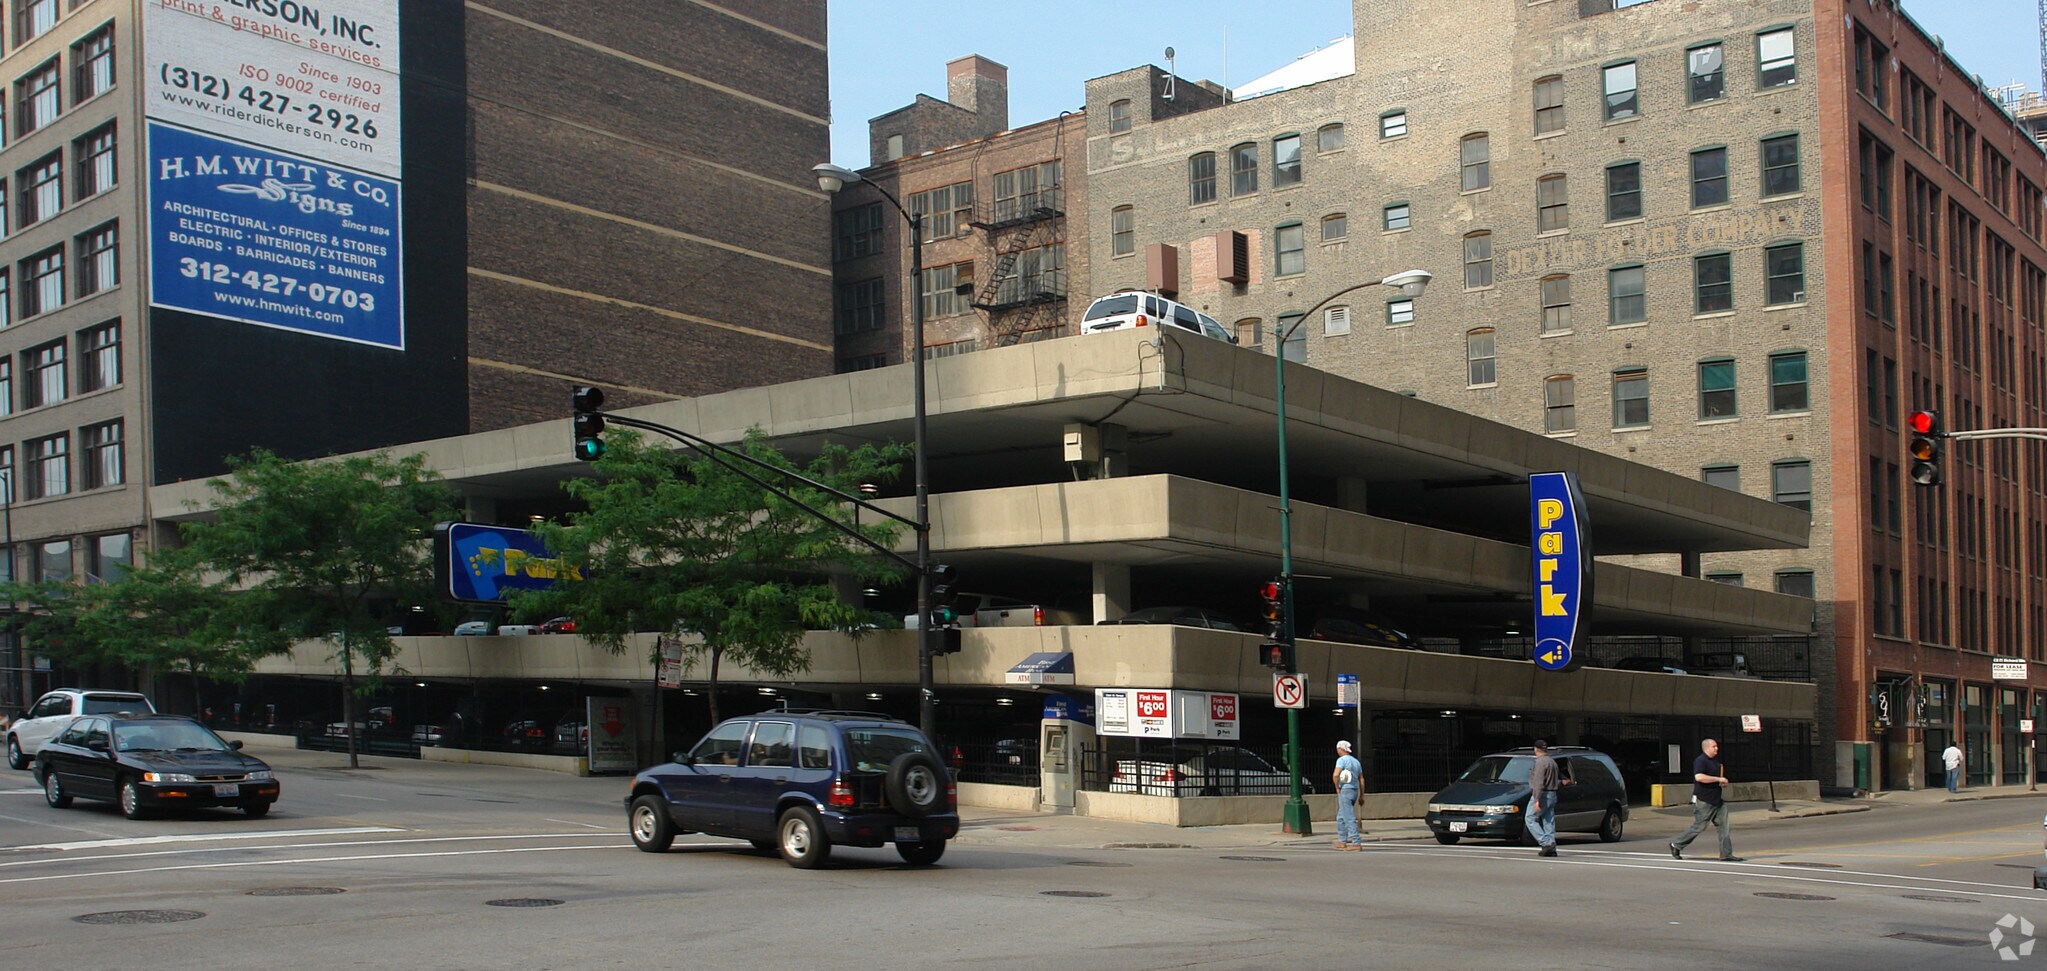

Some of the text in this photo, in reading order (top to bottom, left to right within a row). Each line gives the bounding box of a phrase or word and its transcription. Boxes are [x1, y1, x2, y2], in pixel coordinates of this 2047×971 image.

[161, 0, 381, 68] print & graphic services
[332, 14, 381, 49] INC.
[160, 62, 379, 139] (312) 427-2926
[239, 63, 381, 113] ISO 9002 certified
[298, 61, 382, 96] Since 1903
[161, 90, 374, 153] www.riderdickerson.com
[160, 154, 390, 208] H. M. WITT & CO.
[217, 178, 354, 217] Signs
[163, 200, 388, 257] ARCHITECTURAL OFFICES & STORES
[179, 217, 377, 269] ELECTRIC INTERIOR/EXTERIOR
[341, 218, 367, 233] Since
[1687, 206, 1806, 249] COMPANY
[169, 231, 385, 285] BOARDS BARRICADES BANNERS
[180, 257, 375, 312] 312-427-0703
[214, 290, 345, 324] www.hmwitt.com
[1538, 498, 1568, 617] Park
[1018, 674, 1030, 682] ATM
